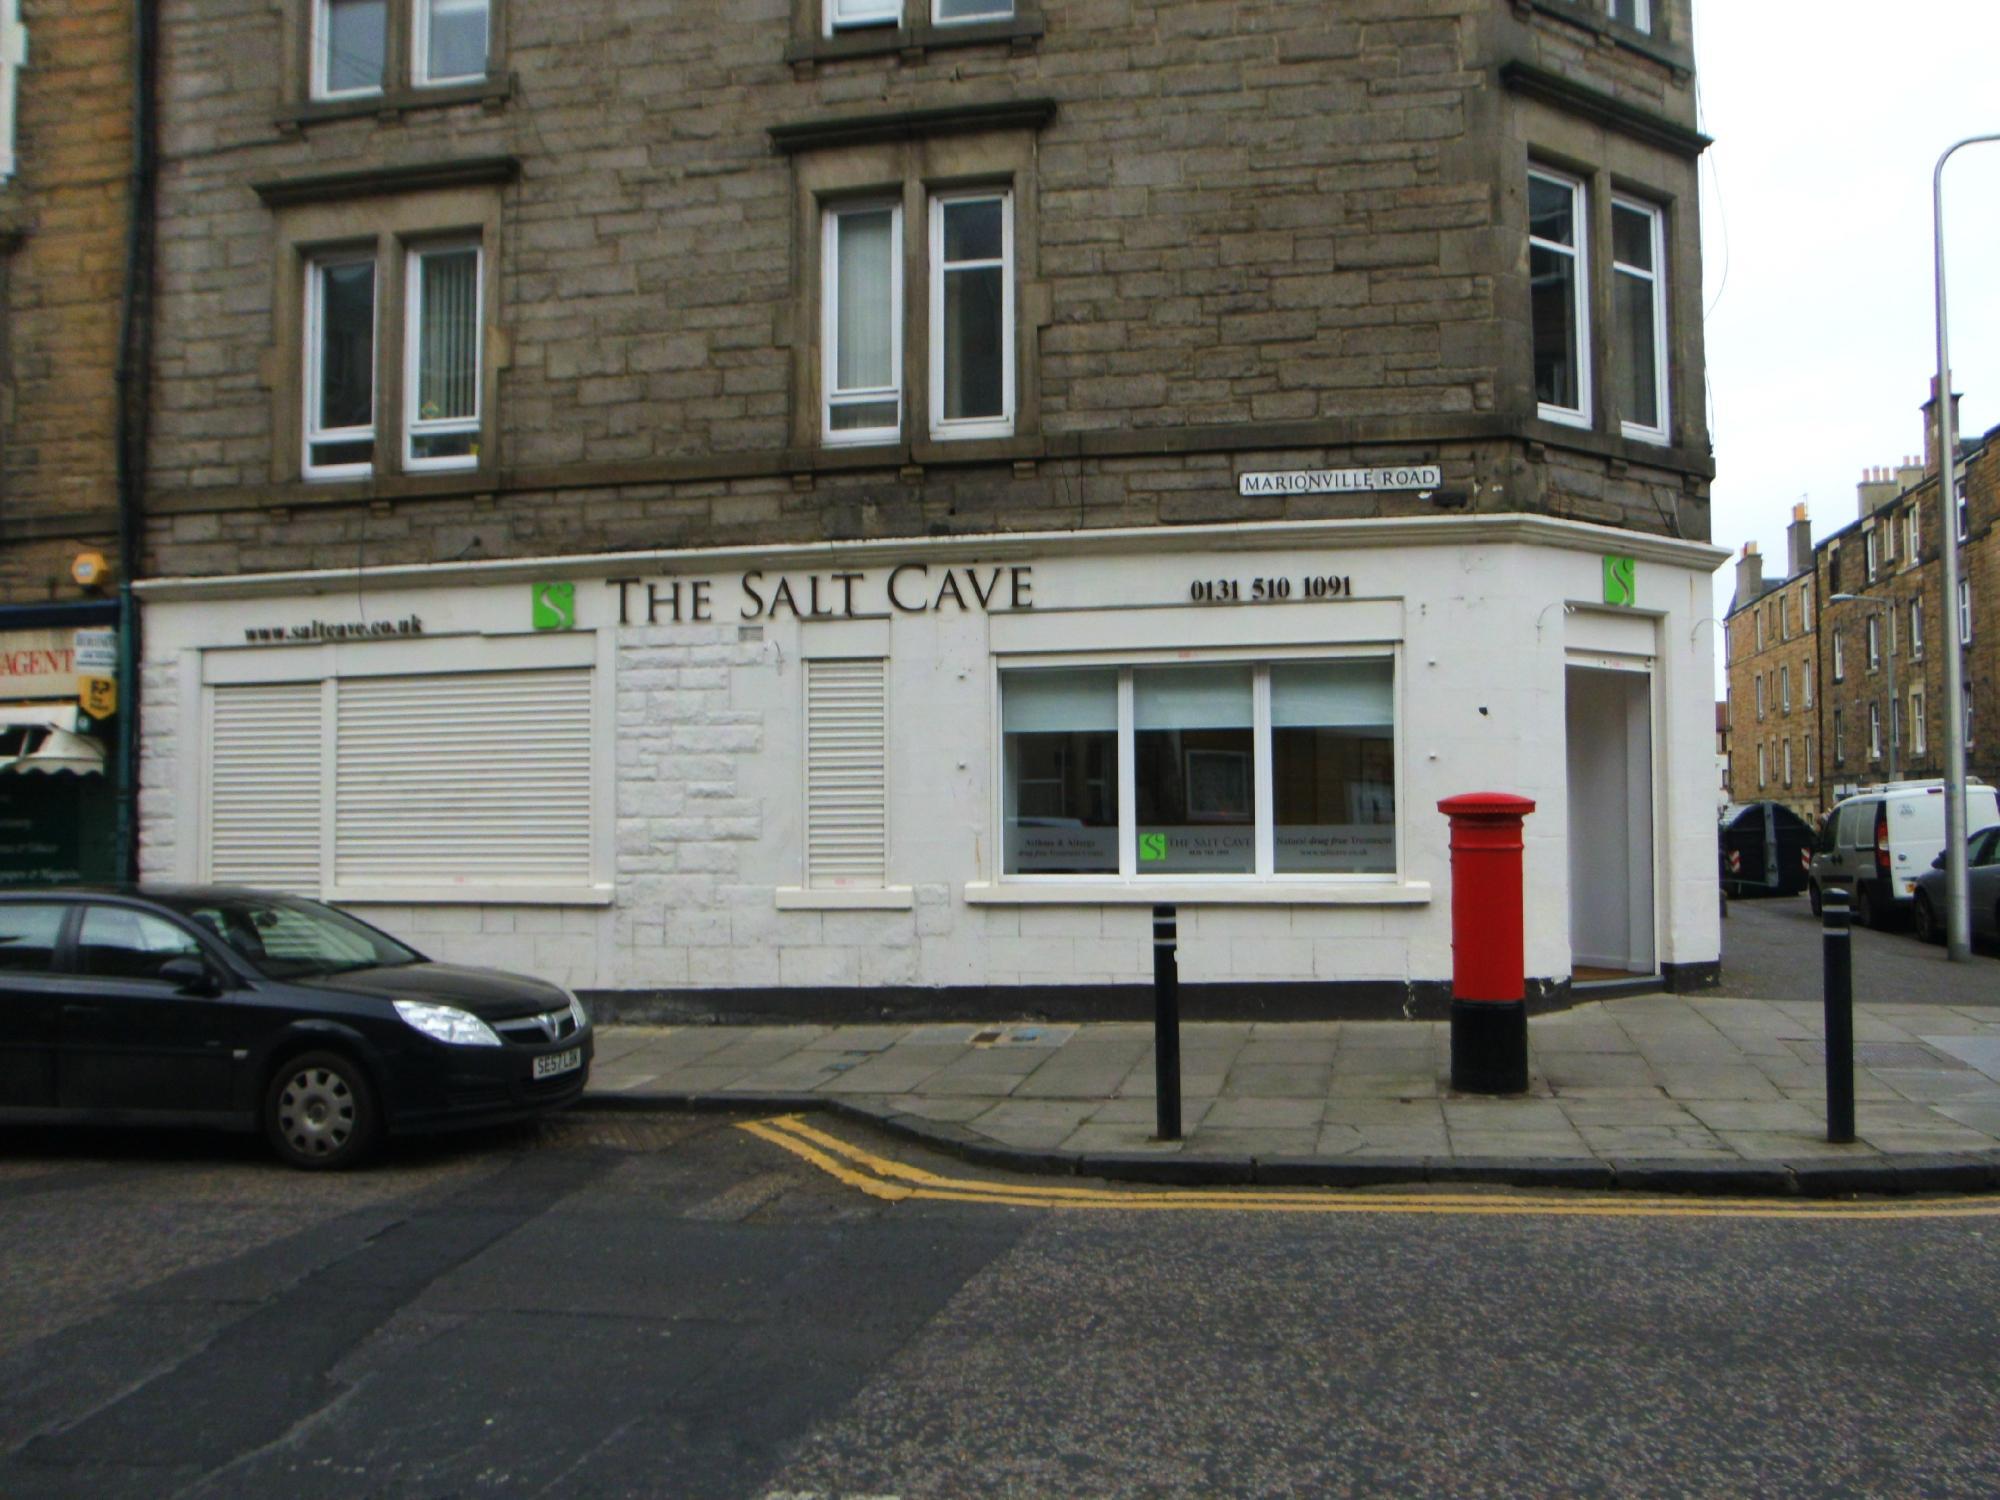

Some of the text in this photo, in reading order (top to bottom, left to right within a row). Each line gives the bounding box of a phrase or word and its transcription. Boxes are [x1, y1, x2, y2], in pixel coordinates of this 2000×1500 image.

[1245, 469, 1435, 491] MARIONVILLE ROAD
[605, 562, 1034, 626] THE SALT CAVE
[1190, 575, 1352, 601] 0131 510 1091
[244, 614, 424, 642] www.saltcave.co.uk
